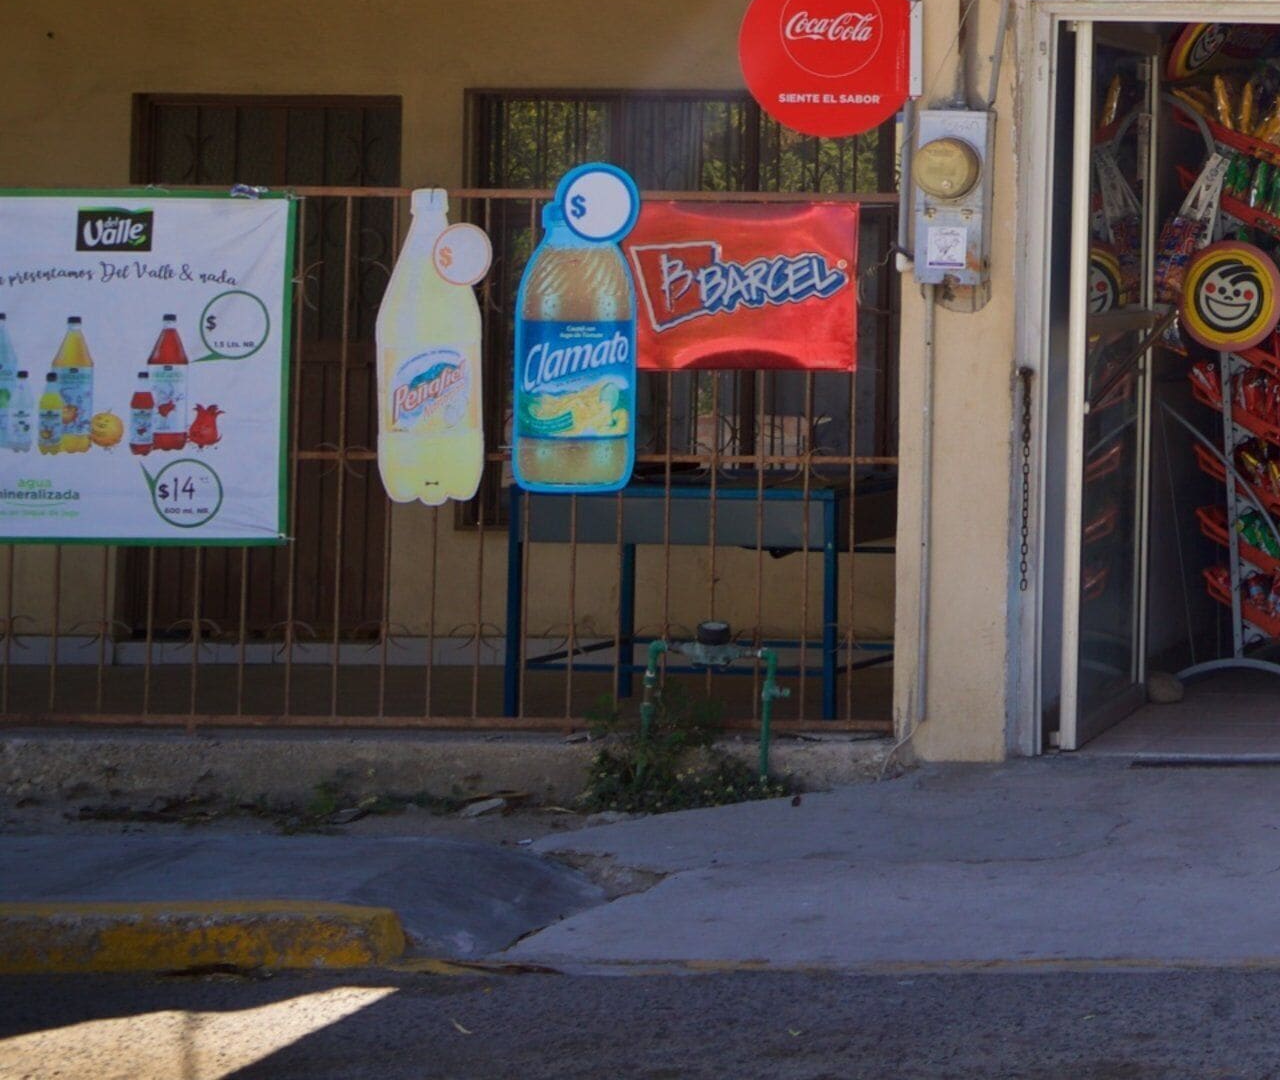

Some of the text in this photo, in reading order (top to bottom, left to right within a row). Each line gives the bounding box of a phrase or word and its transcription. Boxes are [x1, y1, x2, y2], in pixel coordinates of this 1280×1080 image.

[785, 11, 878, 43] Coca-Cola
[779, 93, 880, 105] SIENTE EL SABOR
[571, 195, 587, 219] $
[83, 218, 144, 247] Valle
[440, 247, 453, 268] $
[9, 269, 93, 287] presentamos
[100, 261, 130, 282] Del
[134, 261, 174, 281] Valle
[697, 254, 848, 312] BARCEL
[206, 315, 217, 331] $
[523, 331, 630, 391] Clamato
